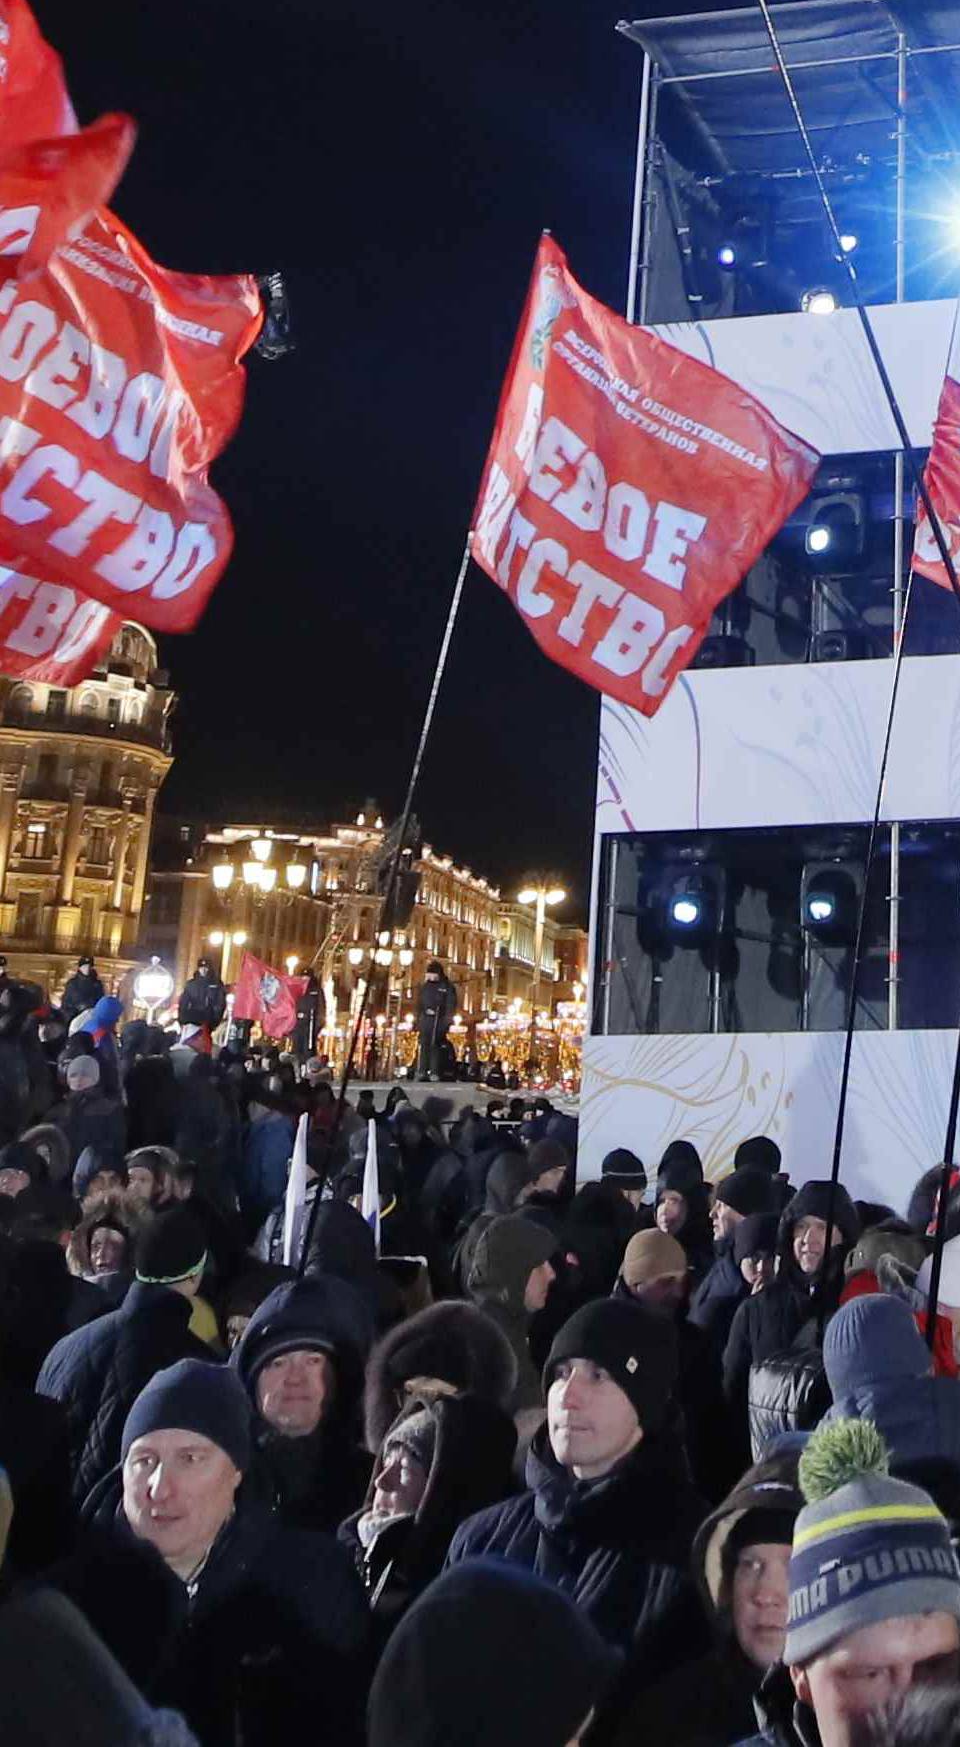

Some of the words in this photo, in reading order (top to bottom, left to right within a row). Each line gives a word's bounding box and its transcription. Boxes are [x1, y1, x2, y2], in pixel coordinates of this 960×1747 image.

[0, 286, 183, 478] ОЕВО
[642, 398, 769, 472] ОБЩЕСТВЕННАЯ
[515, 382, 707, 590] ЕВОЕ
[789, 1576, 829, 1624] MA
